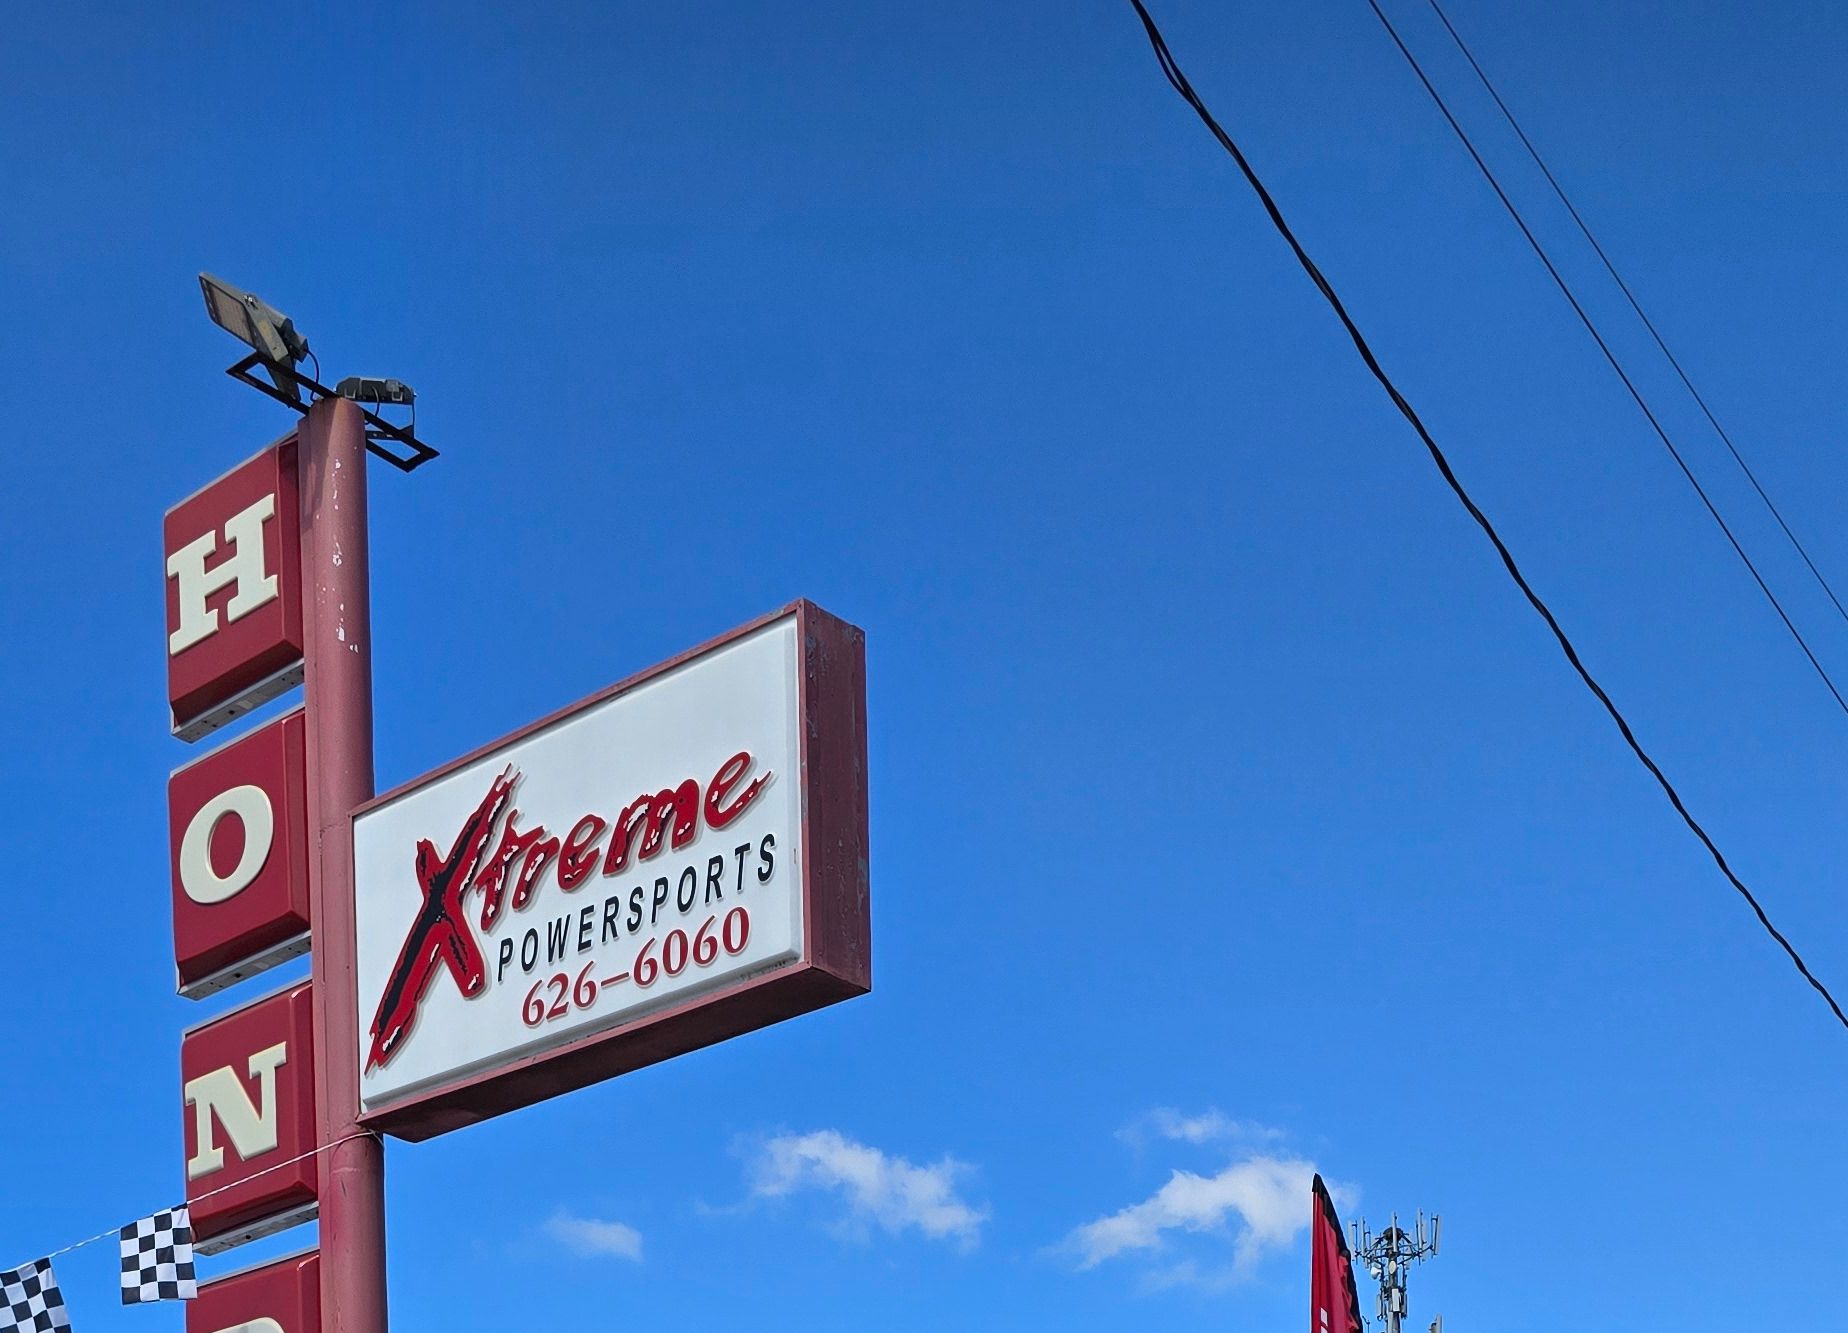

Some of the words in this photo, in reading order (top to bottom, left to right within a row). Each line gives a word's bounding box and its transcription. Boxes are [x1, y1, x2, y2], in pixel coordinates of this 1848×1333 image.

[364, 751, 772, 1076] Xtreme
[497, 832, 776, 984] POWERSPORTS
[521, 905, 751, 1028] 626-6060
